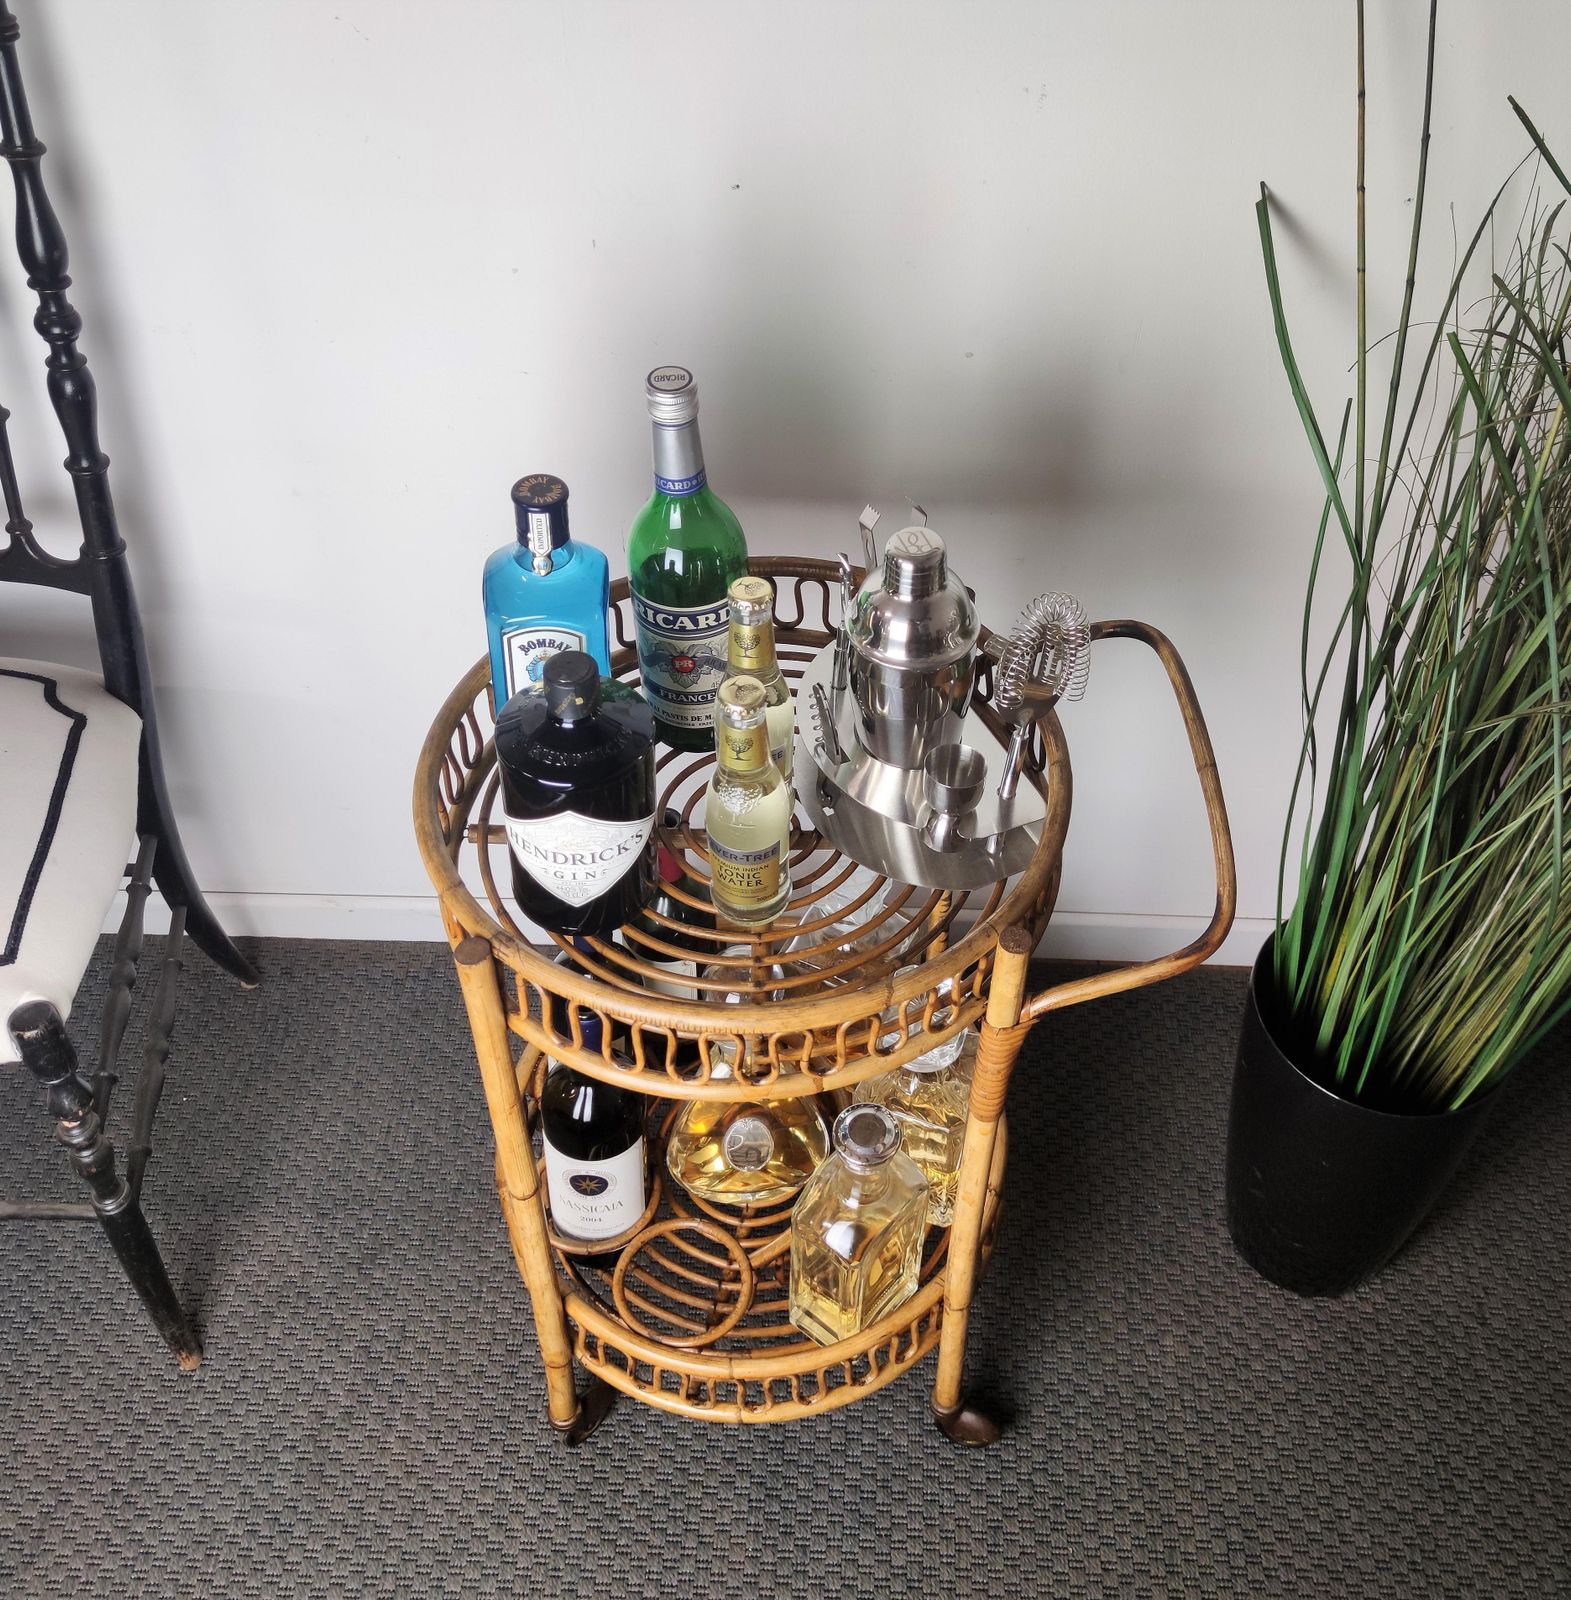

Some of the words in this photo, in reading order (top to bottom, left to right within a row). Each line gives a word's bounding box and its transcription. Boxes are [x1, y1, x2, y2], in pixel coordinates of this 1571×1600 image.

[653, 374, 686, 383] RICARD
[518, 476, 550, 498] BOMBAY
[518, 638, 573, 656] BOMBAY
[673, 660, 694, 669] PR
[660, 688, 717, 703] FRANCE
[661, 710, 690, 722] PASTIS
[508, 825, 644, 866] HENDRICK'S
[553, 870, 598, 881] GIN
[719, 865, 761, 880] TONIC
[742, 864, 769, 873] INDIAN
[717, 870, 764, 888] WATER
[559, 1193, 625, 1214] SASSICAIA
